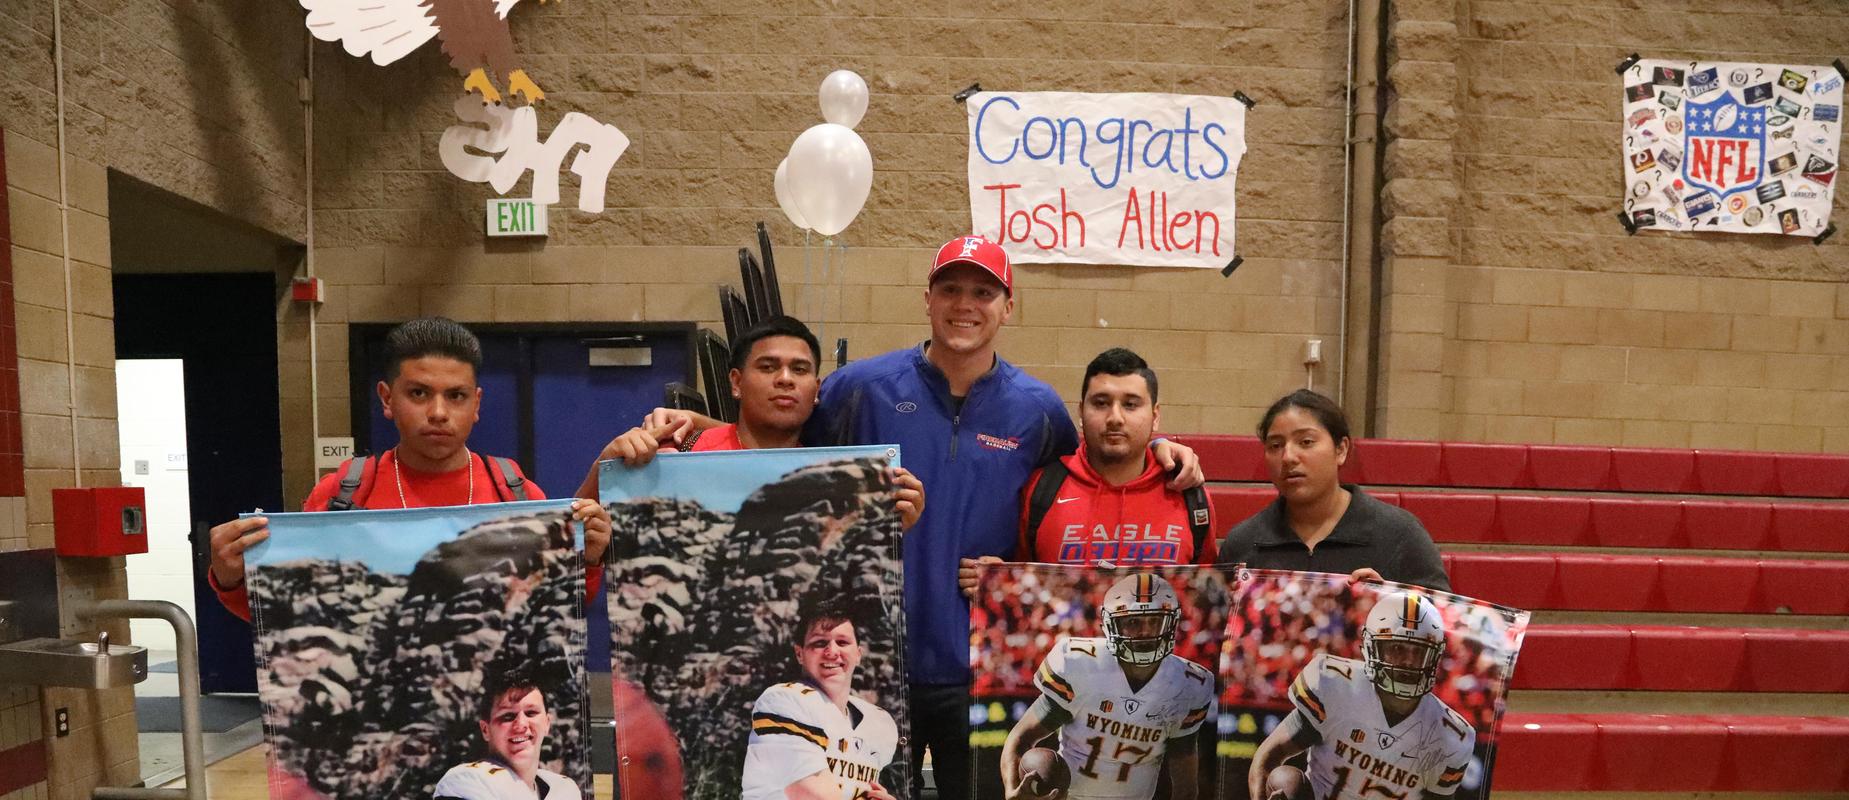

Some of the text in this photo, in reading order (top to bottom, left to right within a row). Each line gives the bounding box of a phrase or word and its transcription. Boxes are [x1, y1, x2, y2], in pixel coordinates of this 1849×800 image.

[975, 96, 1228, 189] Congrats
[1690, 138, 1757, 189] NFL
[497, 203, 535, 232] EXIT
[984, 183, 1220, 257] Josh Allen
[959, 237, 983, 257] F
[167, 454, 187, 462] EXIT
[322, 446, 350, 457] EXIT
[1062, 523, 1184, 541] EAGLE
[1086, 713, 1162, 743] WYOMING
[826, 757, 878, 783] WYOMIN
[1079, 736, 1153, 782] 17
[1334, 739, 1420, 789] WYOMING
